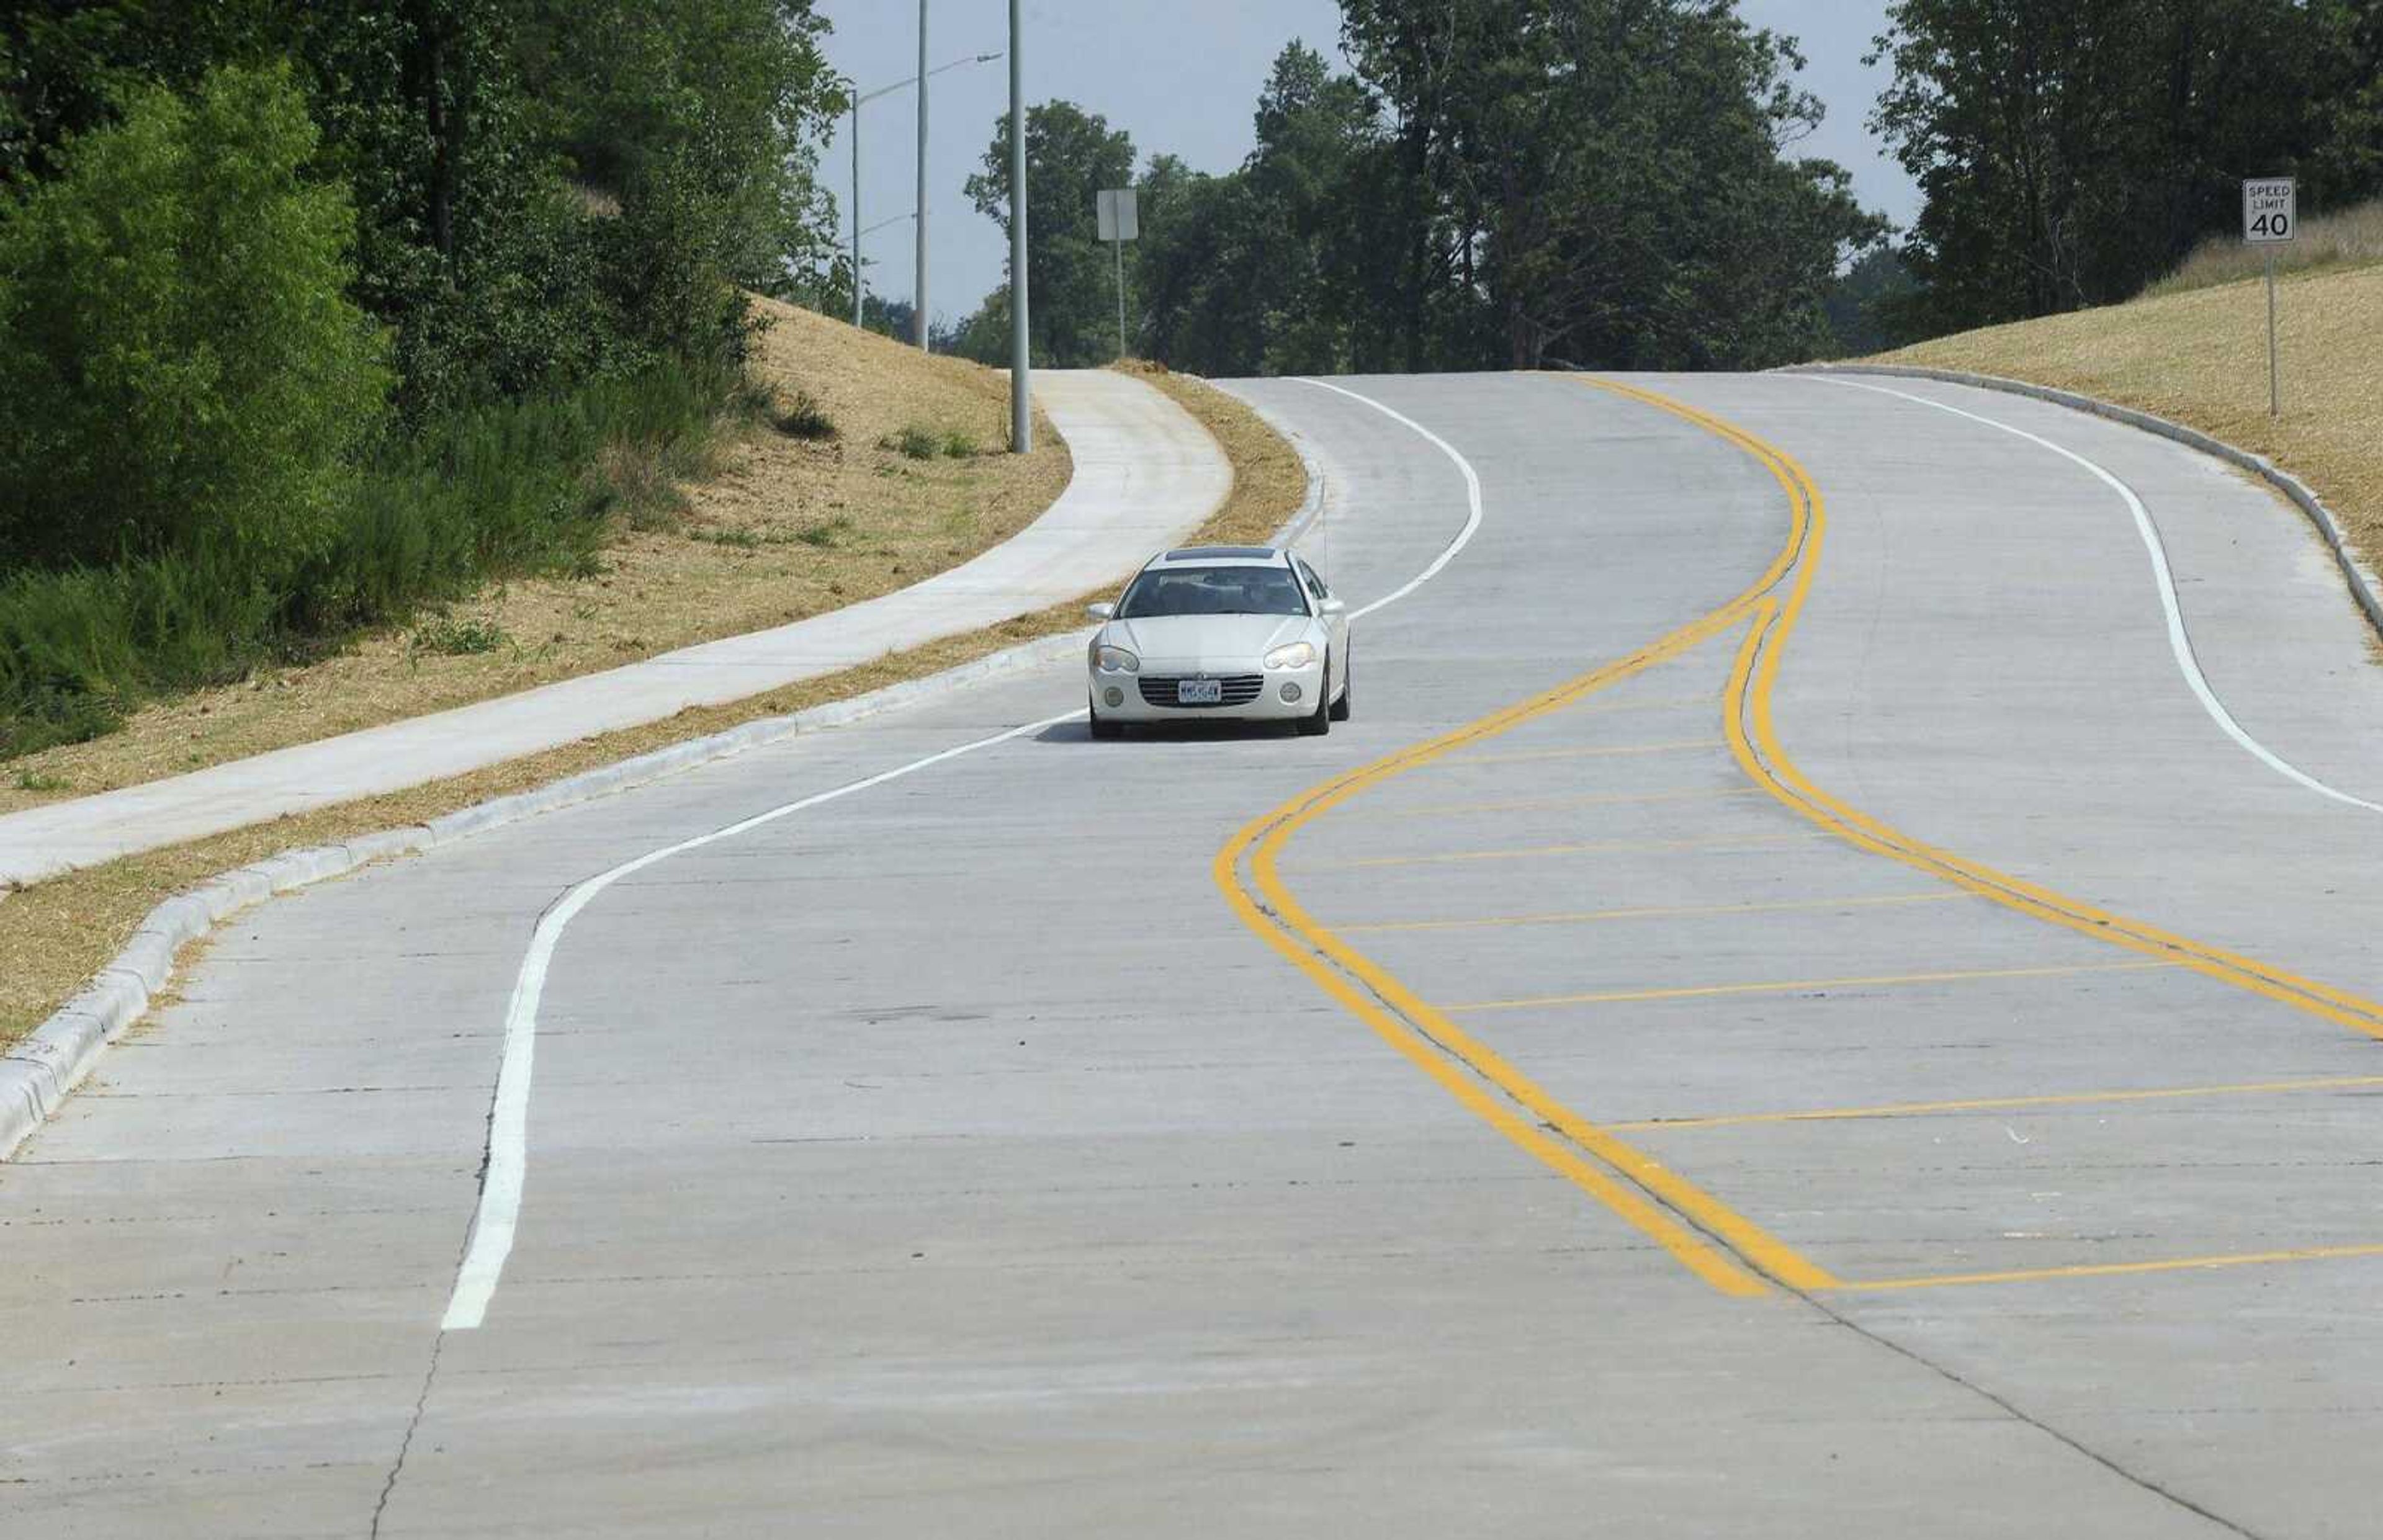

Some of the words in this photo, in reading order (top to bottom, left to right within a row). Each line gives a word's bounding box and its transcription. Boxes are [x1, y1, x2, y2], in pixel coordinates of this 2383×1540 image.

[2249, 186, 2290, 197] SPEED
[2253, 199, 2285, 209] LIMIT
[2250, 214, 2287, 236] 40
